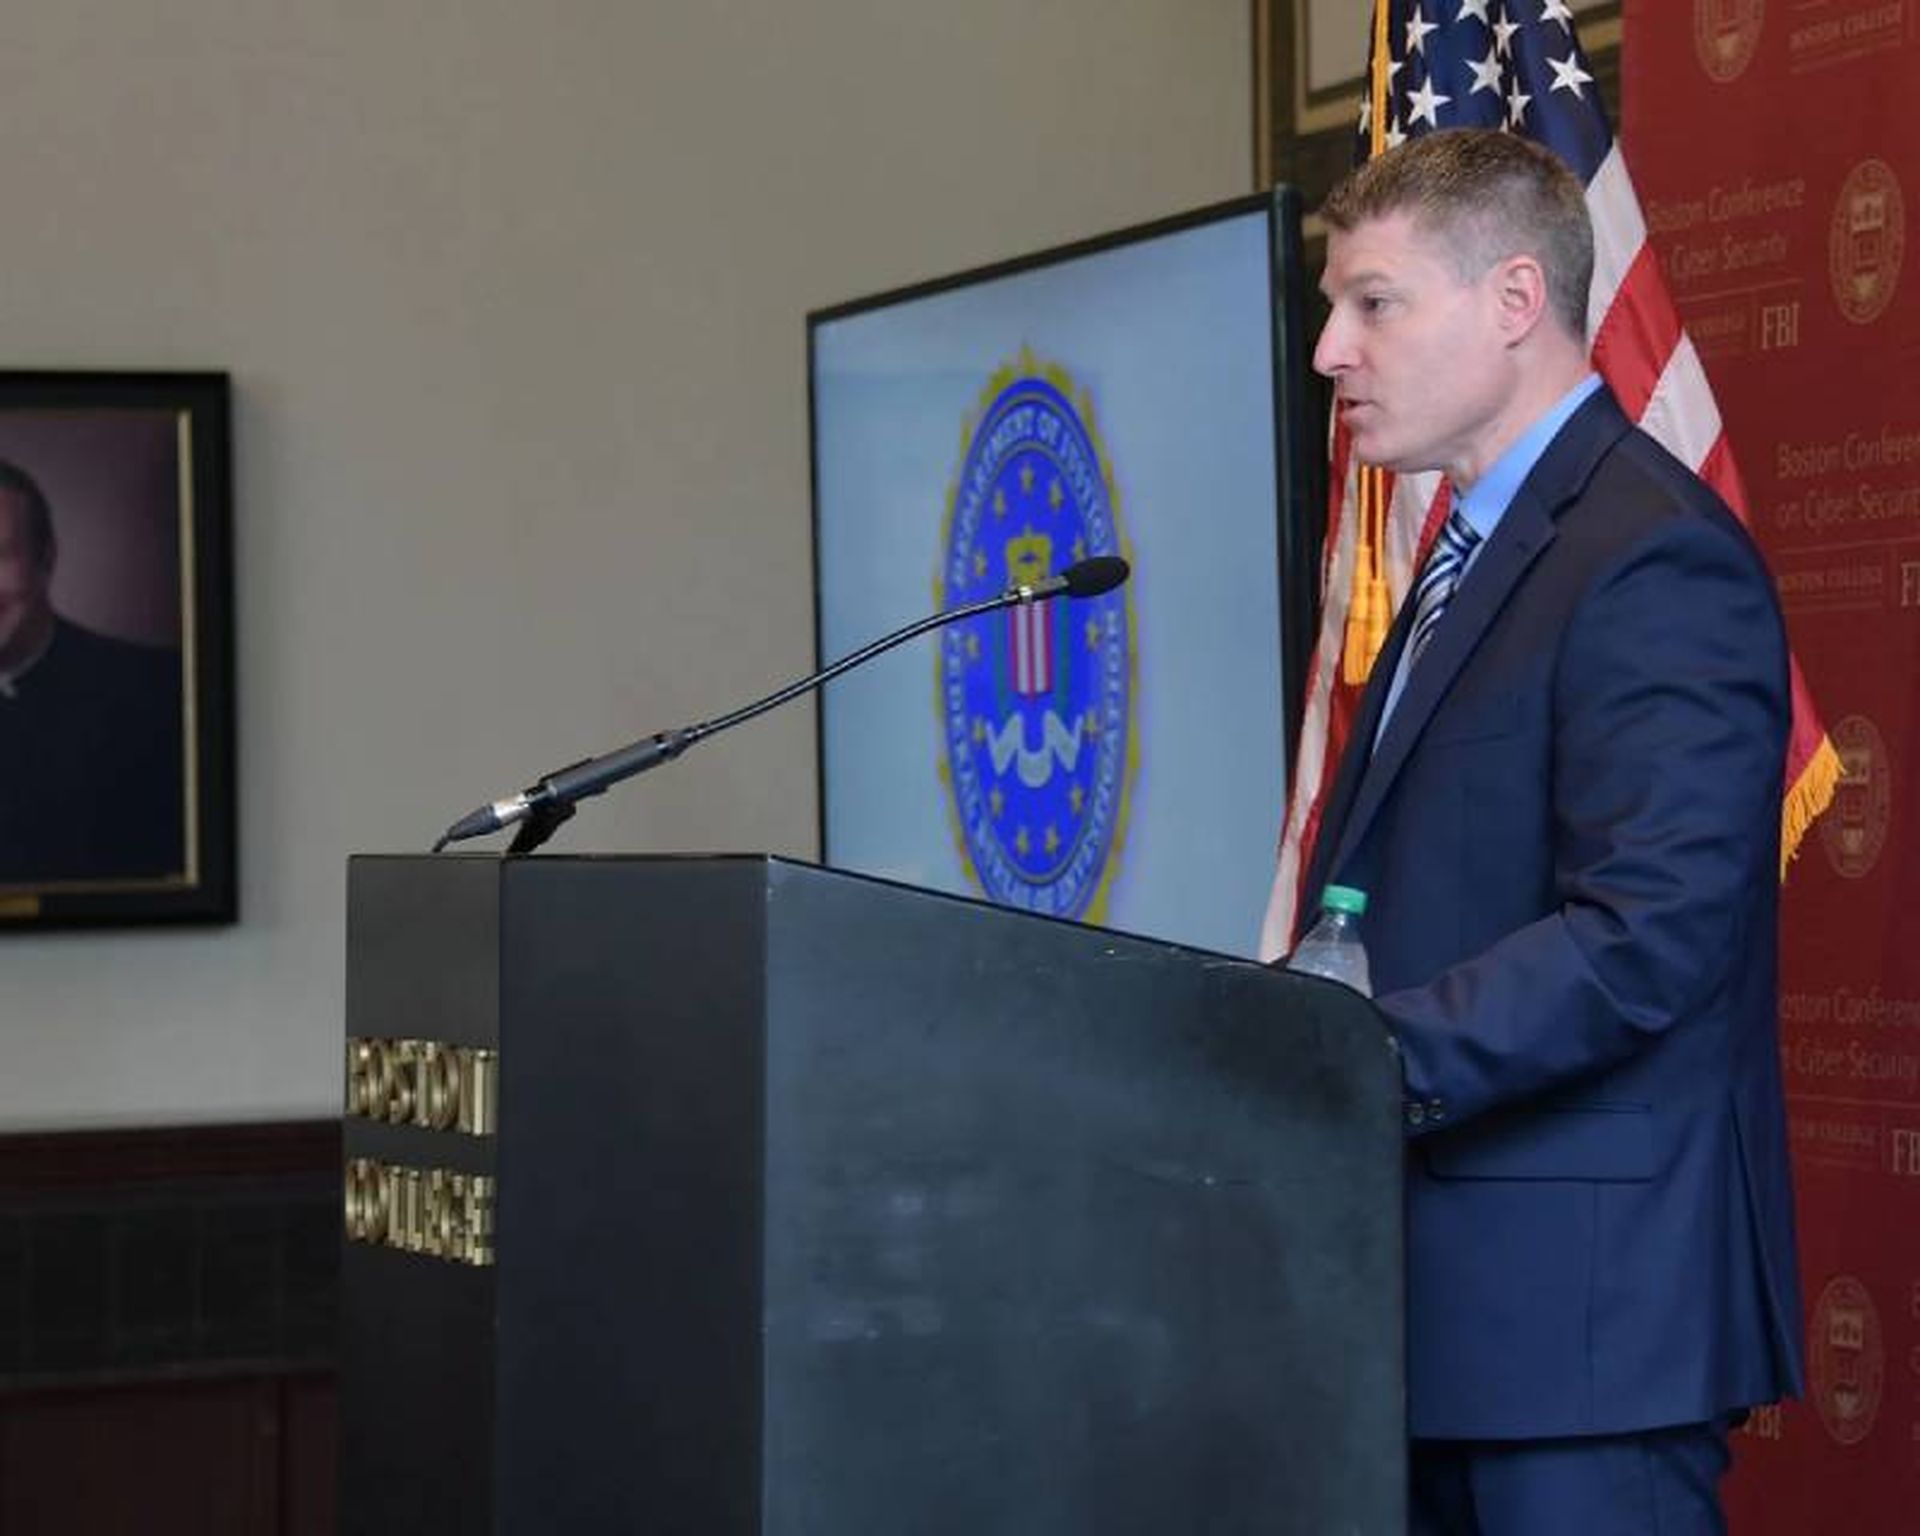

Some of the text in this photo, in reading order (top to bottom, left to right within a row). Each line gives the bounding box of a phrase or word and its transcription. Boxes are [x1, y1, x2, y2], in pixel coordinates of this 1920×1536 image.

[1708, 177, 1805, 224] Conference
[1761, 303, 1800, 350] FBI
[1777, 441, 1840, 479] Boston
[1804, 485, 1850, 535] Cyber
[1777, 993, 1830, 1022] oston
[1794, 1036, 1845, 1080] Cyber
[1846, 1041, 1918, 1095] Security
[1892, 1128, 1920, 1175] FB
